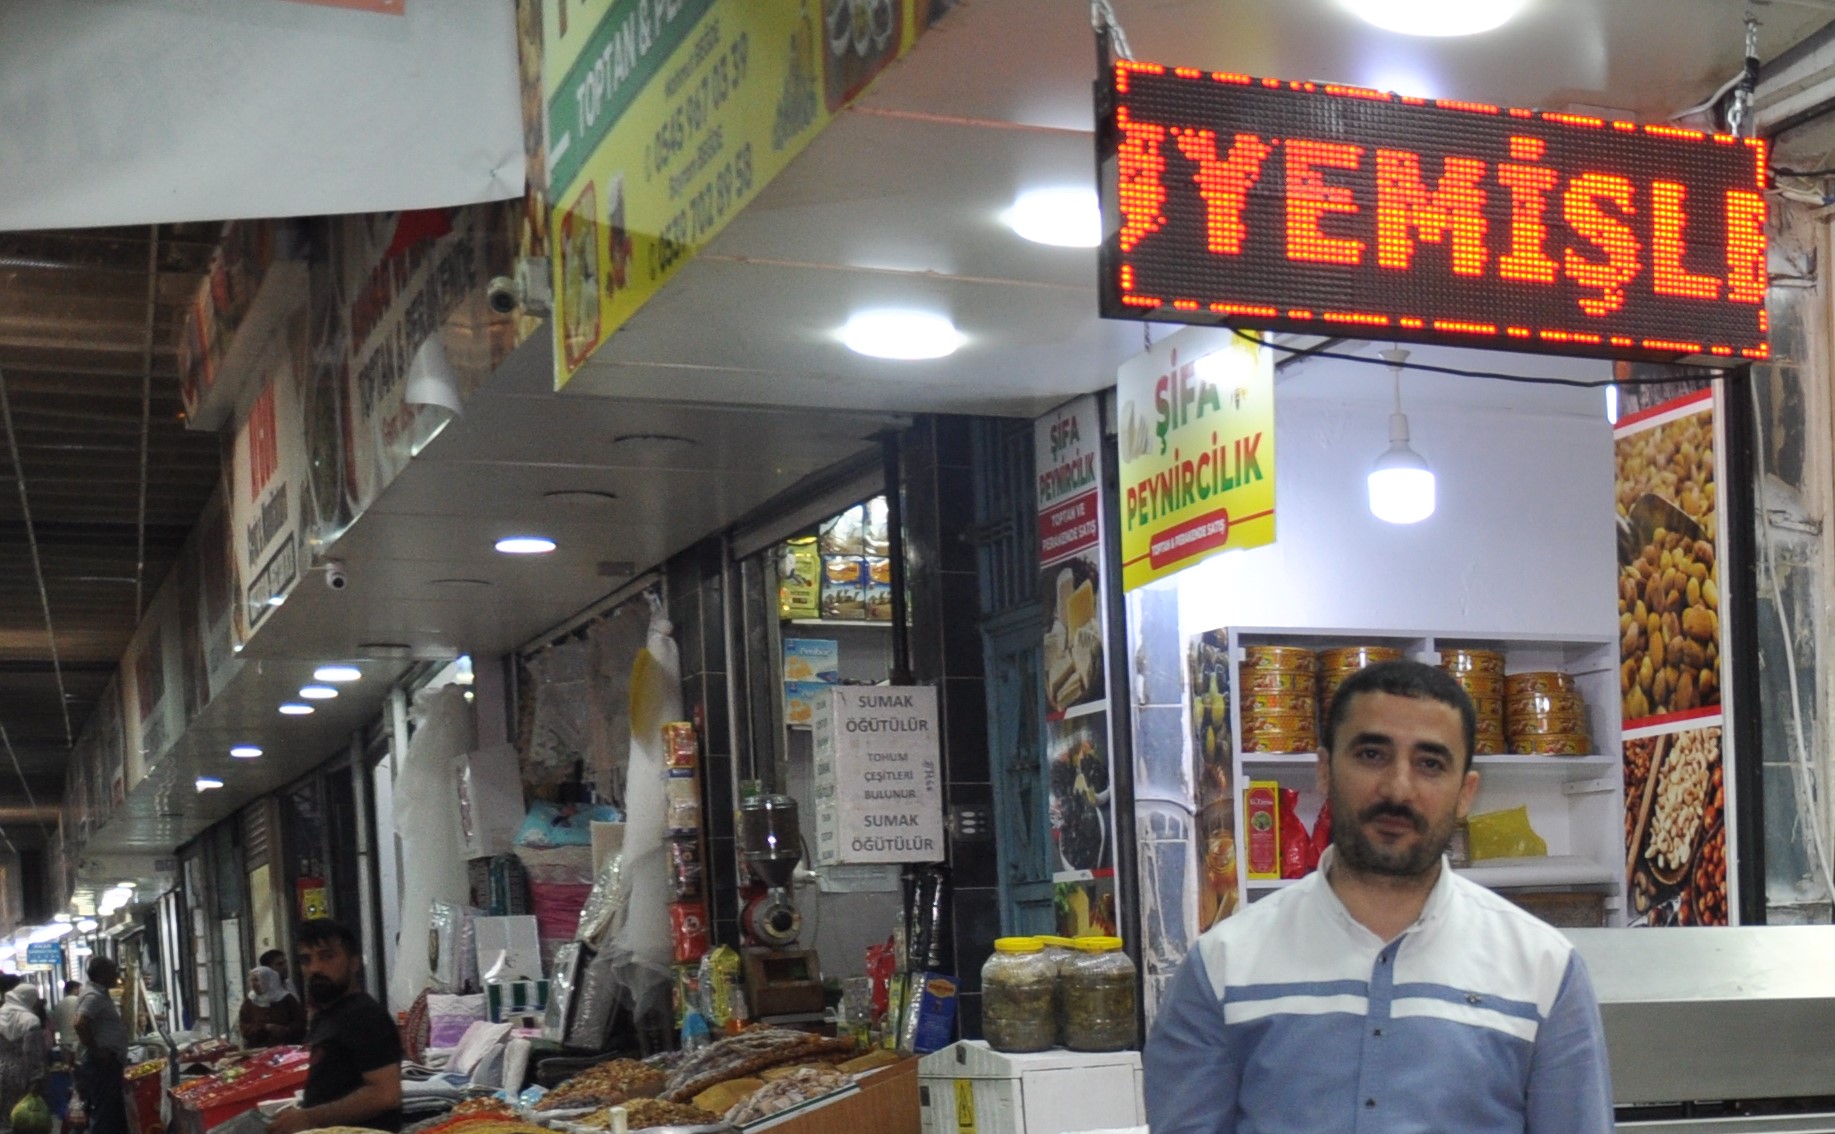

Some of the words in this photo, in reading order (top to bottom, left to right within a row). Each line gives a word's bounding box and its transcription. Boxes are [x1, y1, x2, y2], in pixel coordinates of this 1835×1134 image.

[1155, 348, 1221, 456] ŞİFA
[858, 695, 914, 708] SUMAK
[846, 717, 929, 733] ÖĞÜTÜLÜR
[867, 752, 909, 762] TOHUM
[864, 770, 914, 783] ÇEŞİTLERİ
[864, 789, 916, 800] BULUNUR
[864, 814, 919, 827] SUMAK
[851, 834, 934, 851] ÖĞÜTÜLÜR
